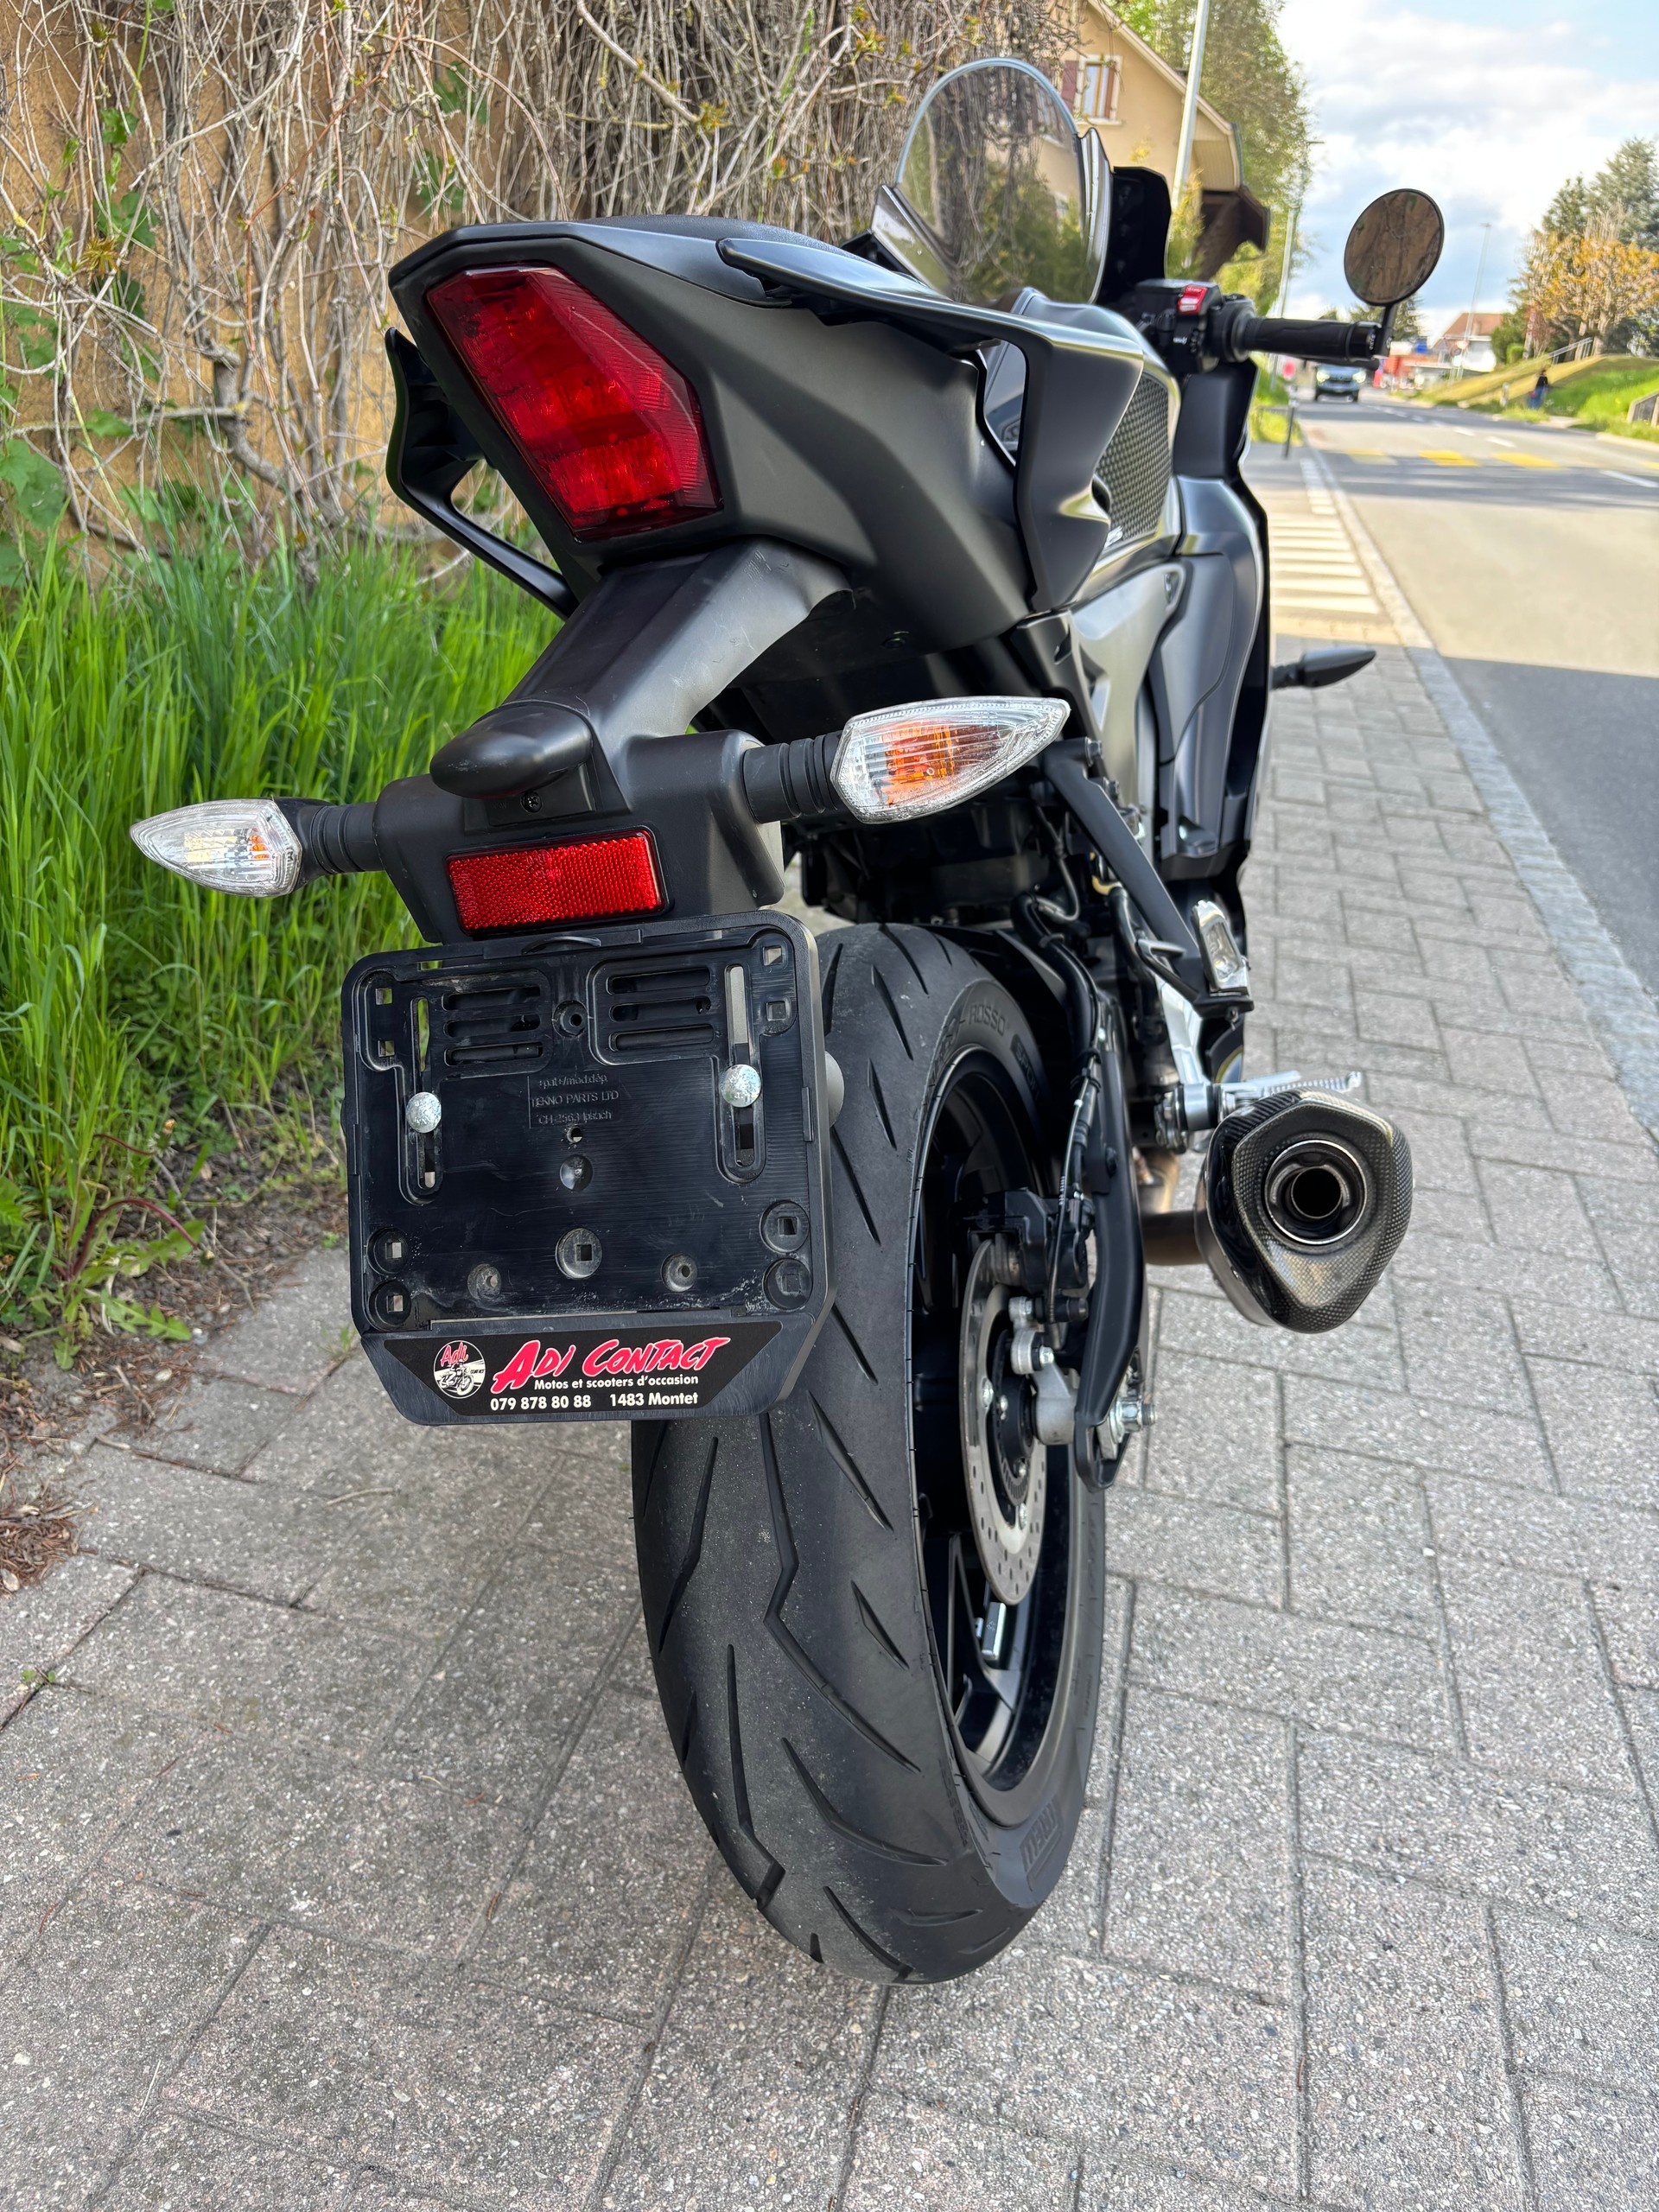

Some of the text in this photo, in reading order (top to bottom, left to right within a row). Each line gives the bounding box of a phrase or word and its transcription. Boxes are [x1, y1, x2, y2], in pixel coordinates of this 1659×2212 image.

[969, 1003, 1006, 1037] ROSSO
[566, 1091, 599, 1104] PARTS
[601, 1090, 620, 1102] LTD
[440, 1341, 469, 1367] Adi
[582, 1337, 732, 1377] CONTACT
[534, 1374, 699, 1390] Motos et scooters d'occasion
[490, 1392, 699, 1411] 079 878 80 88 1483 Montet
